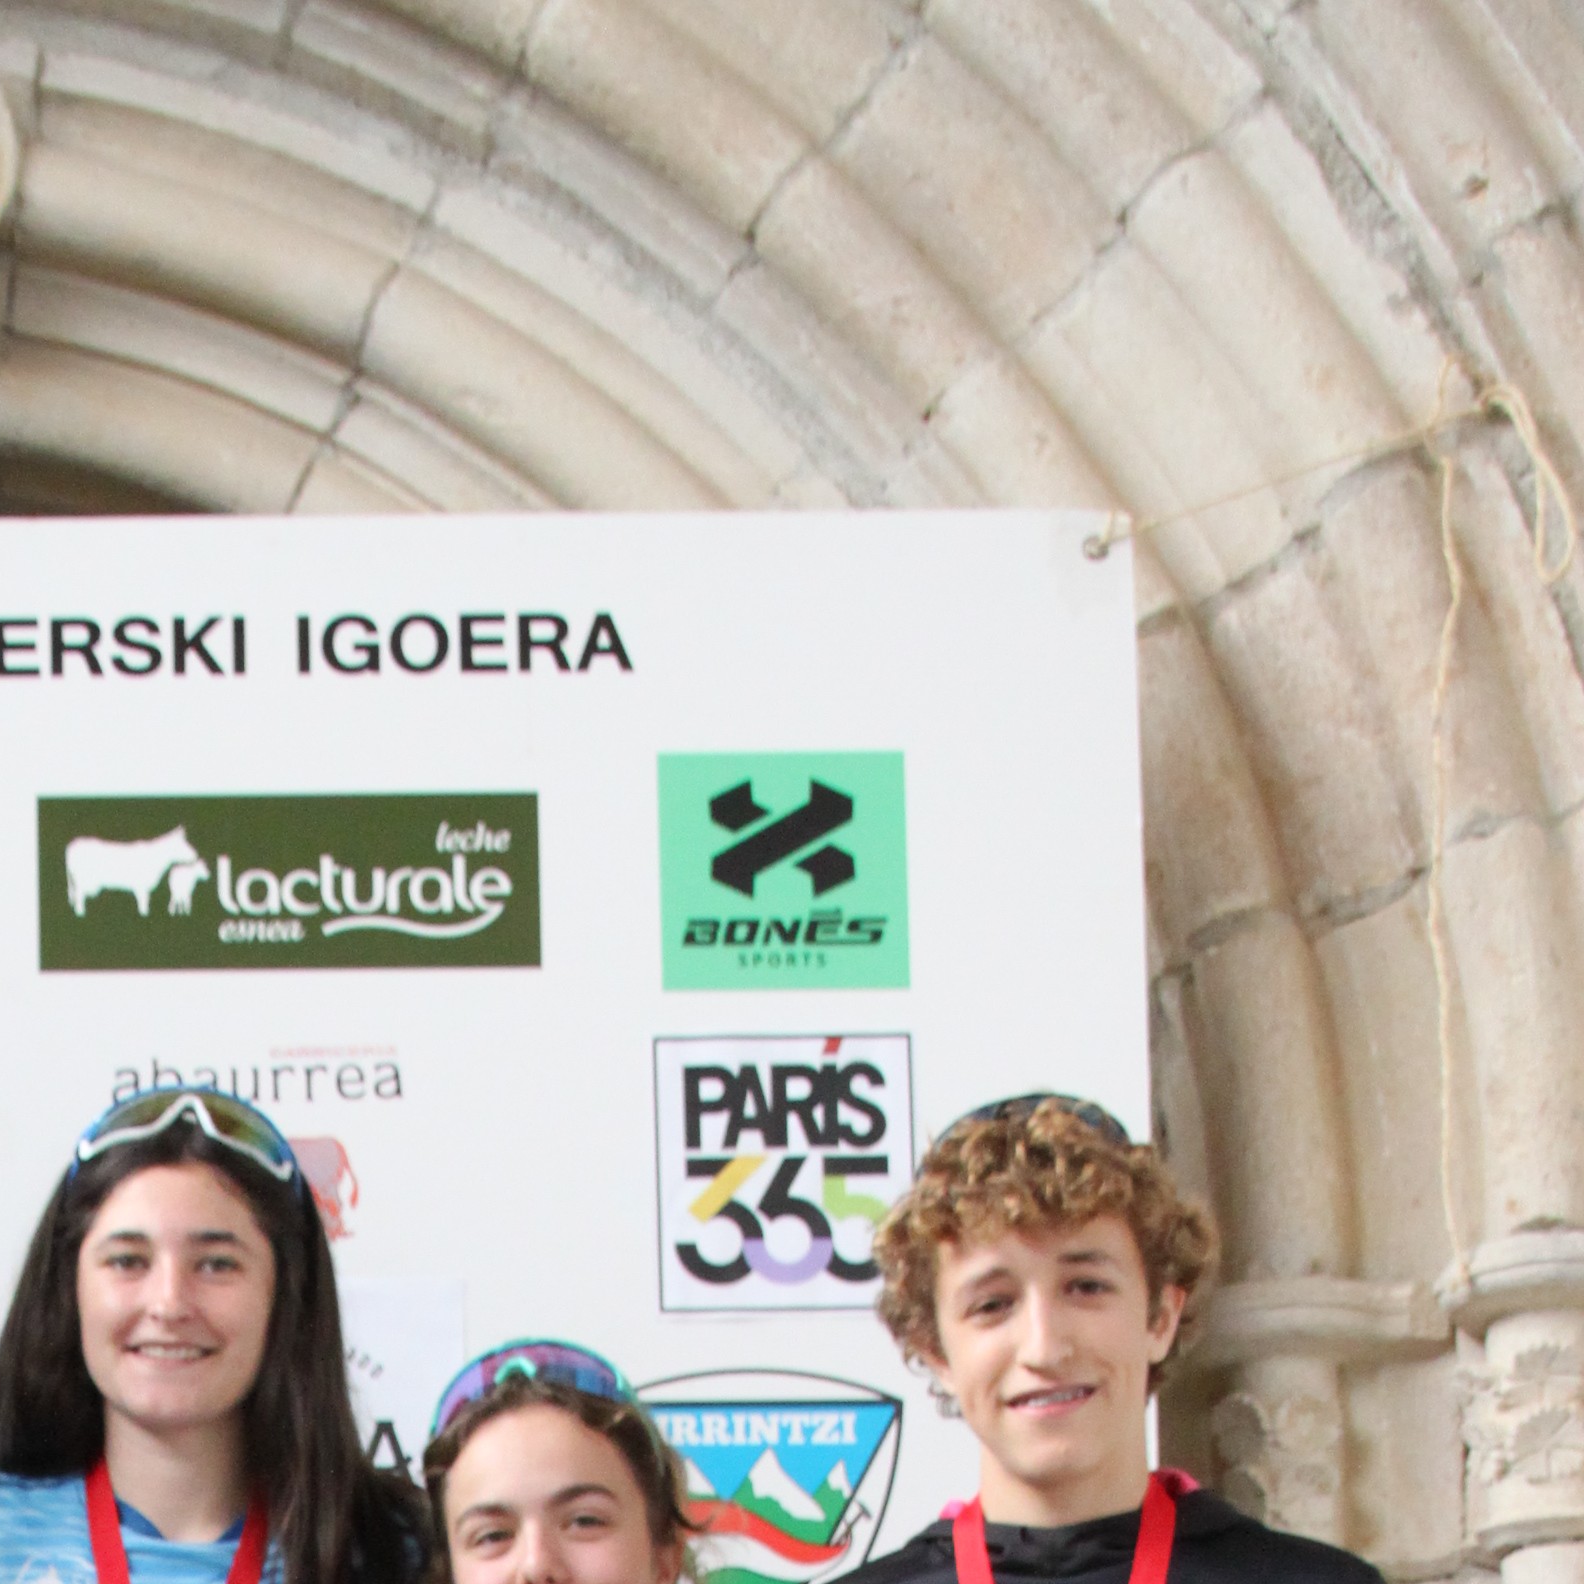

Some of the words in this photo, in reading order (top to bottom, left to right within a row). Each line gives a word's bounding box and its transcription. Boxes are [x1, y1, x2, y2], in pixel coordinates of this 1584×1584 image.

[297, 612, 634, 675] IGOERA
[436, 822, 510, 853] leche
[217, 854, 513, 918] lacturale
[738, 953, 826, 968] SPORTS
[675, 1155, 890, 1285] 365
